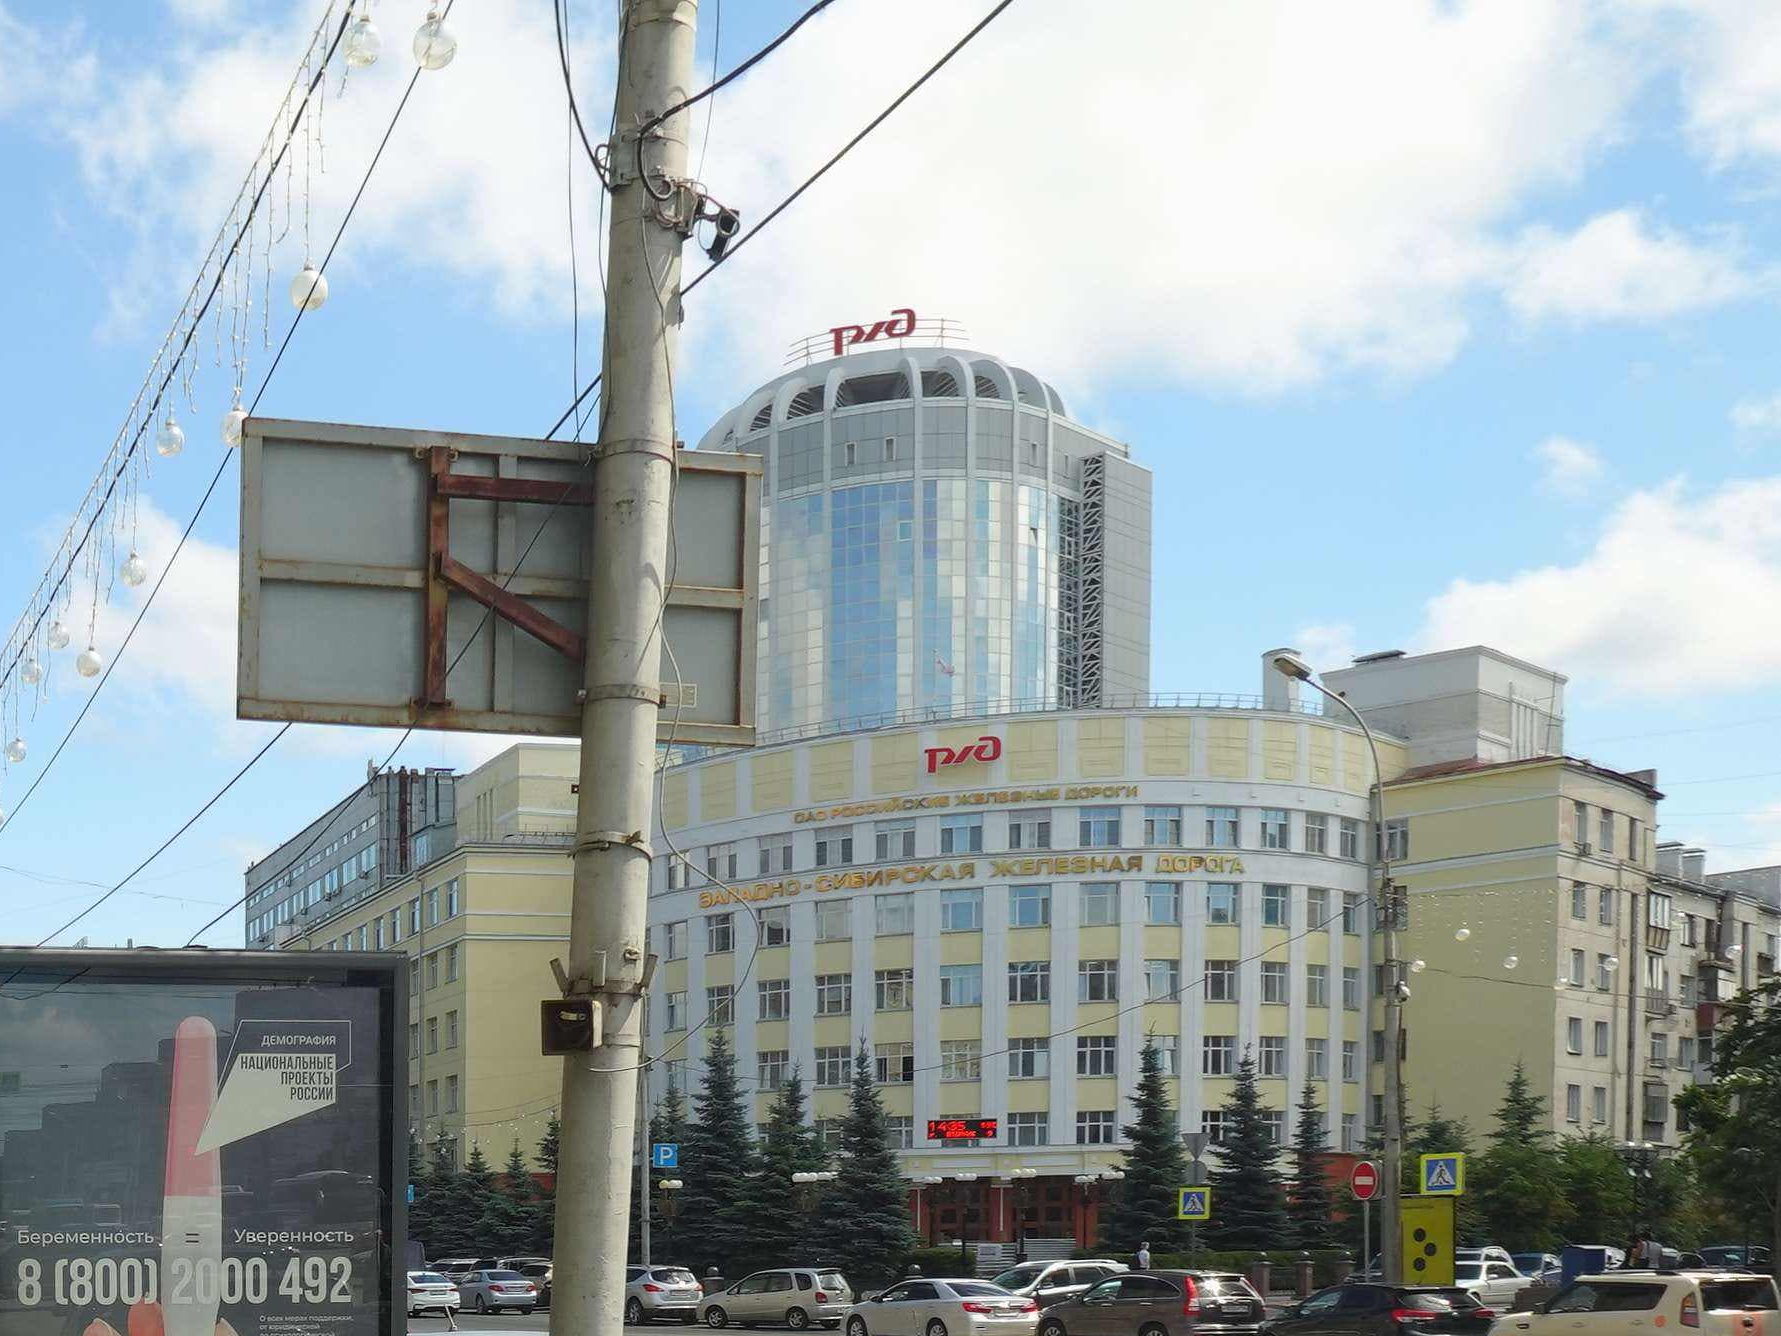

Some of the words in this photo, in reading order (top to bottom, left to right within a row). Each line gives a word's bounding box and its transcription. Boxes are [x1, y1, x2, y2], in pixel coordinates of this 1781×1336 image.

[794, 810, 828, 824] ОАО
[831, 796, 950, 818] РОССИЙСКИЕ
[955, 788, 1061, 806] ЖЕЛЕЗНЫЕ
[1065, 785, 1138, 801] ДОРОГИ
[990, 855, 1144, 878] ЖЕЛЕЗНАЯ
[1155, 854, 1247, 874] ДОРОГА
[261, 1034, 337, 1047] ДЕМОГРАФИЯ
[240, 1055, 334, 1071] НАЦИОНАЛЬНЫЕ
[281, 1071, 334, 1085] ПРОЕКТЫ
[290, 1087, 334, 1101] РОССИИ
[17, 1229, 155, 1245] Беременность
[233, 1228, 355, 1244] Уверенность
[17, 1258, 42, 1306] 8
[54, 1258, 158, 1306] (800)
[171, 1256, 268, 1305] 2000
[278, 1256, 353, 1304] 492
